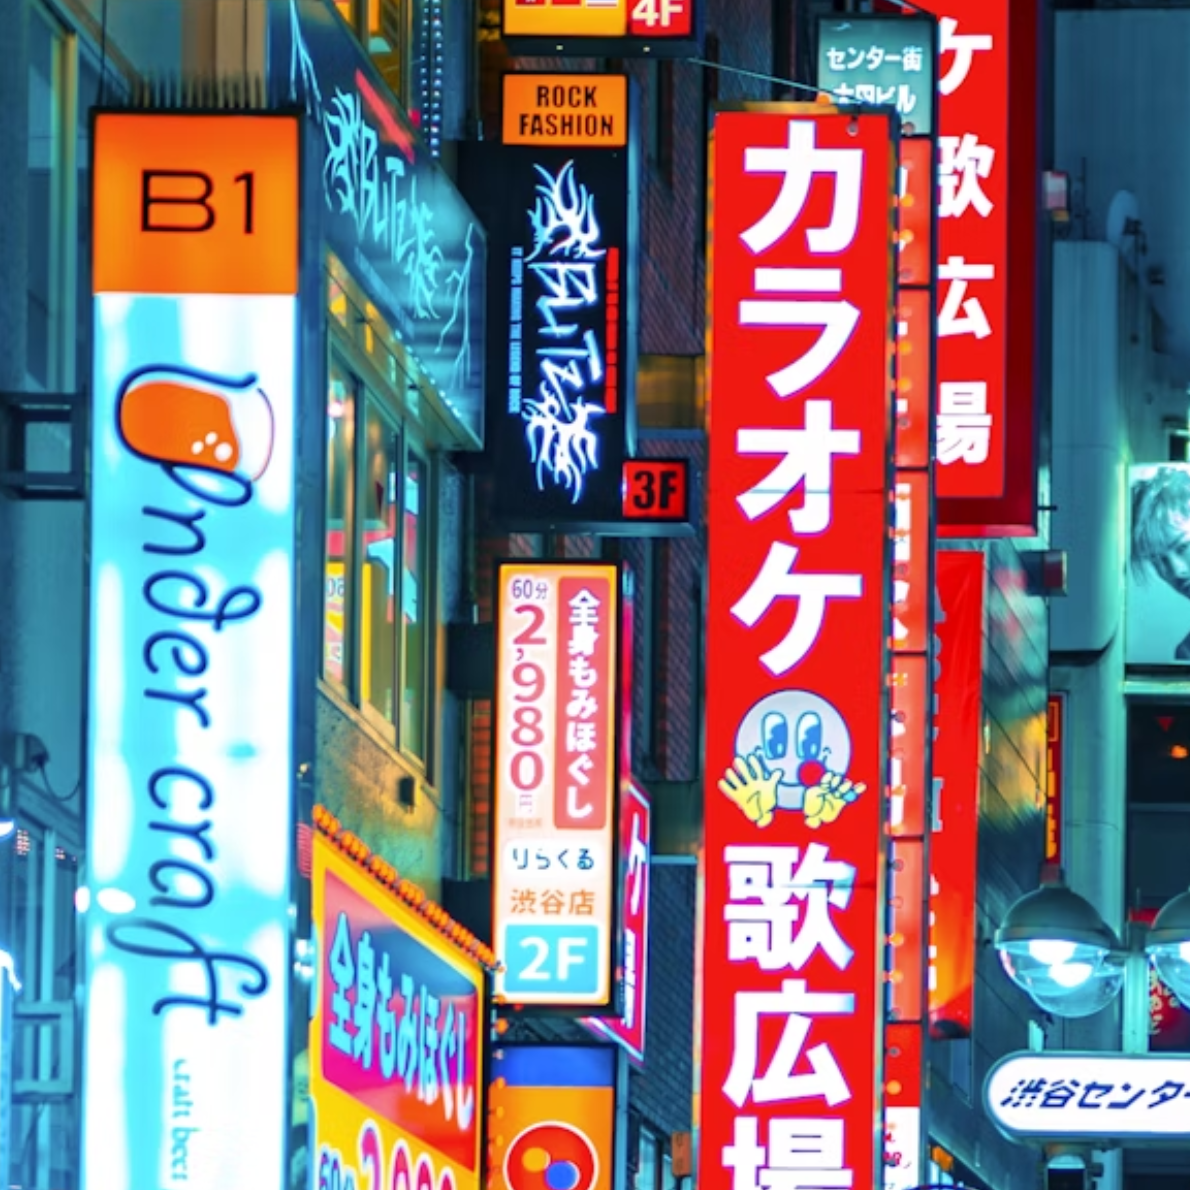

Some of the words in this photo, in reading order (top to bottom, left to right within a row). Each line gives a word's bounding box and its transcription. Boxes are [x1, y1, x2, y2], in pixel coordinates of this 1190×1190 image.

[632, 0, 683, 27] 4F
[827, 46, 922, 71] センター街
[536, 85, 597, 108] ROCK
[519, 115, 613, 138] FASHION
[141, 169, 254, 235] B1
[633, 470, 678, 509] 3F
[510, 578, 549, 600] 60分
[566, 588, 601, 820] 全身もみほぐし
[511, 847, 596, 871] りらくる
[106, 765, 268, 1027] craft
[510, 888, 596, 917] 渋谷店
[518, 935, 588, 981] 2F
